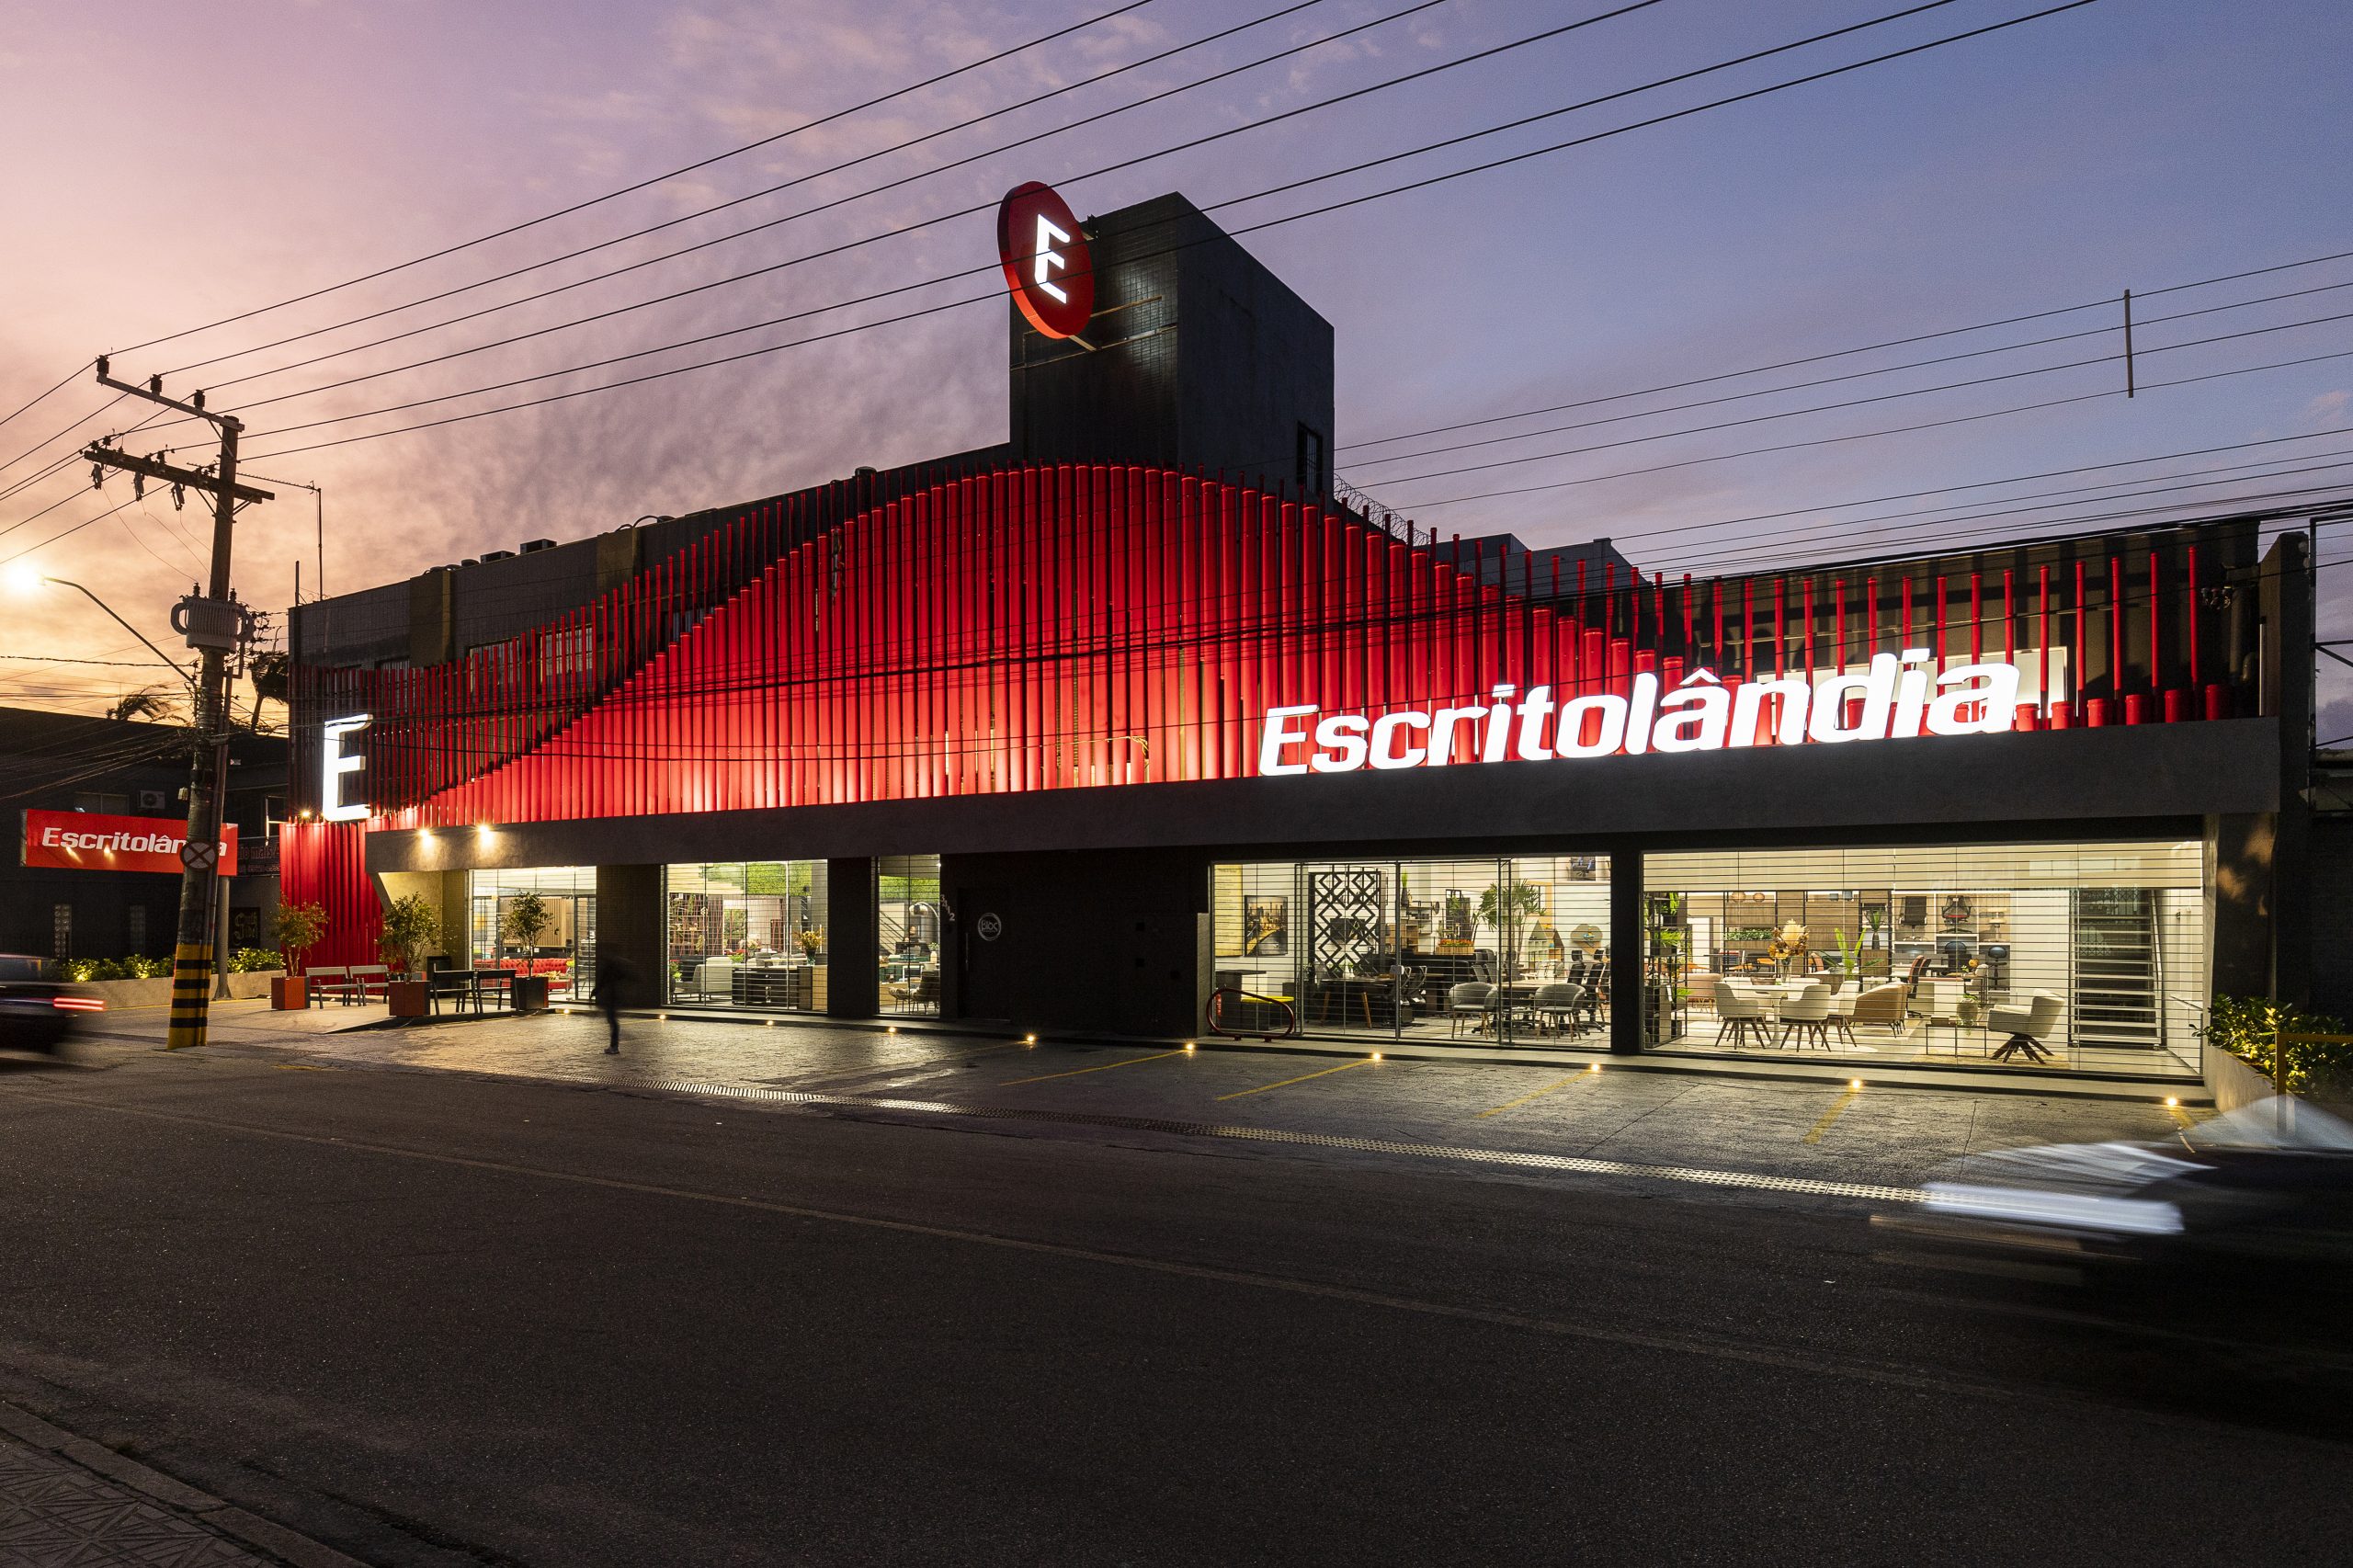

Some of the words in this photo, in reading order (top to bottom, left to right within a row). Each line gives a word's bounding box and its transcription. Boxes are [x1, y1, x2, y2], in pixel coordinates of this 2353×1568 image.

[1035, 214, 1070, 304] E
[1259, 649, 2020, 776] Escritolândia
[323, 714, 372, 821] E
[42, 827, 227, 856] Escritolâna
